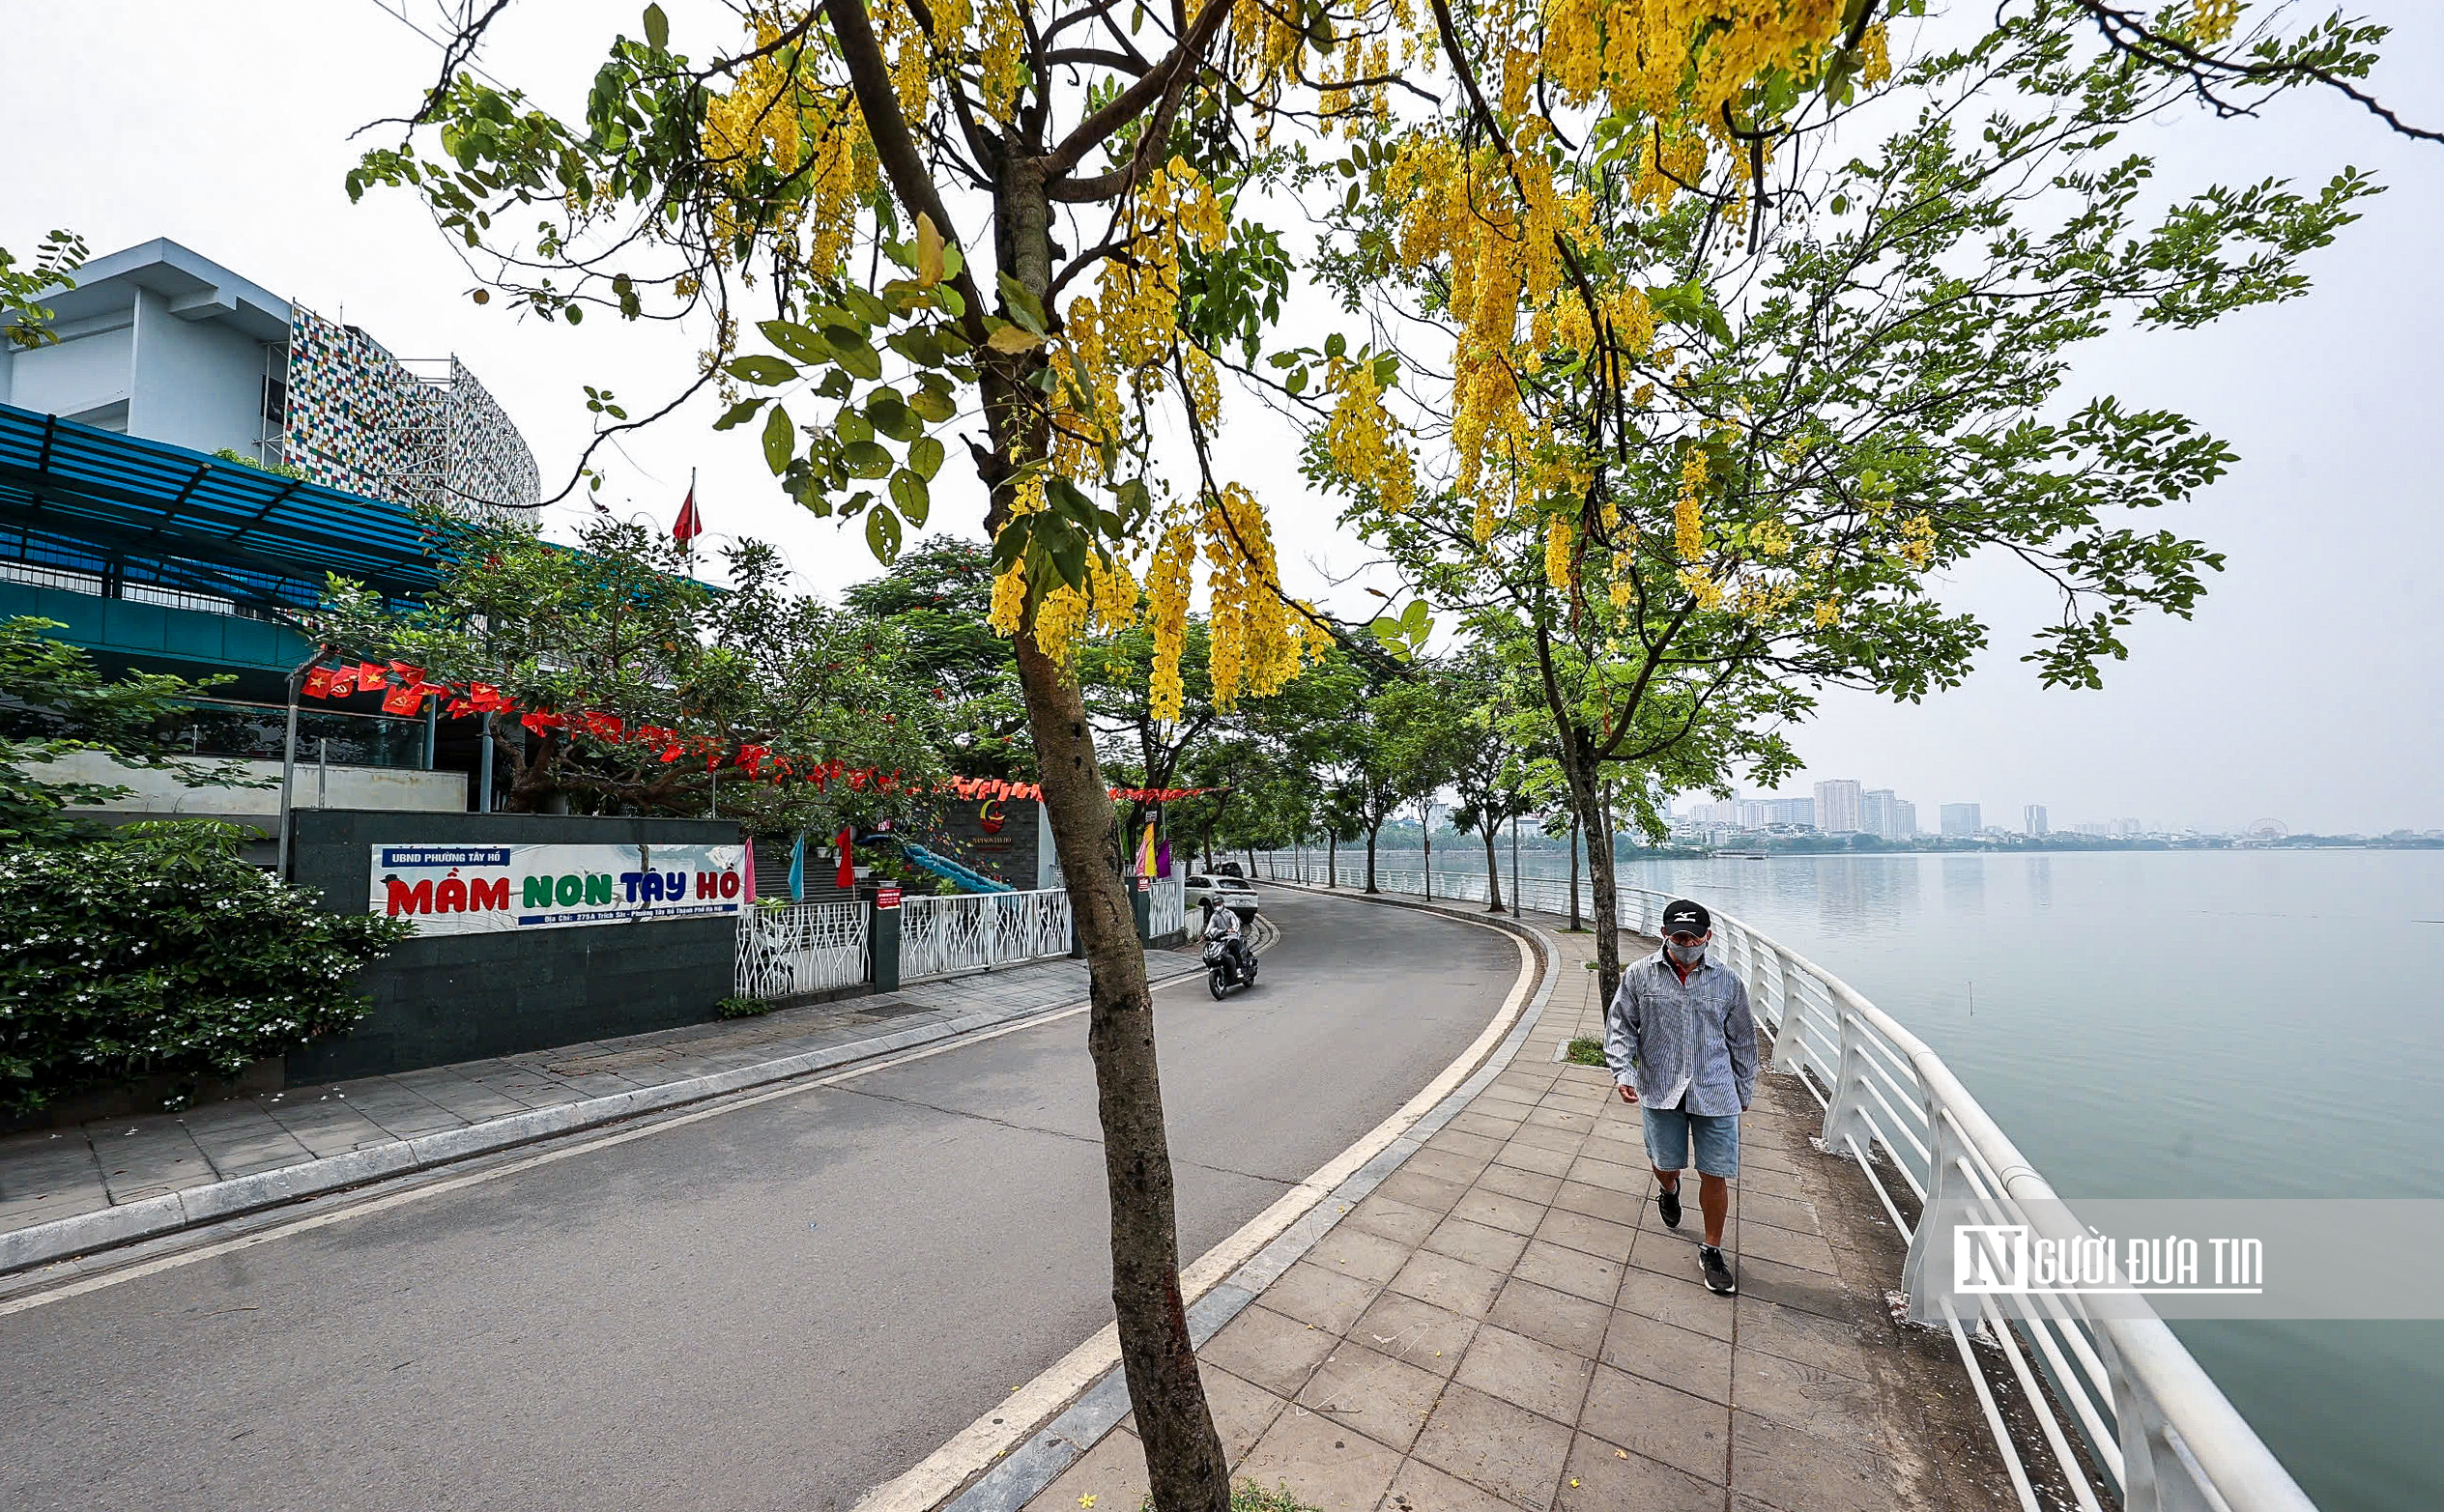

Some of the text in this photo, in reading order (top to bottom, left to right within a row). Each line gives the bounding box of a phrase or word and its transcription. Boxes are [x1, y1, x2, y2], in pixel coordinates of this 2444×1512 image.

[391, 853, 421, 863] UBND
[424, 851, 466, 863] PHƯỜNG
[468, 851, 485, 862] TÂY
[387, 862, 741, 917] MẦM NON TÂY HỒ
